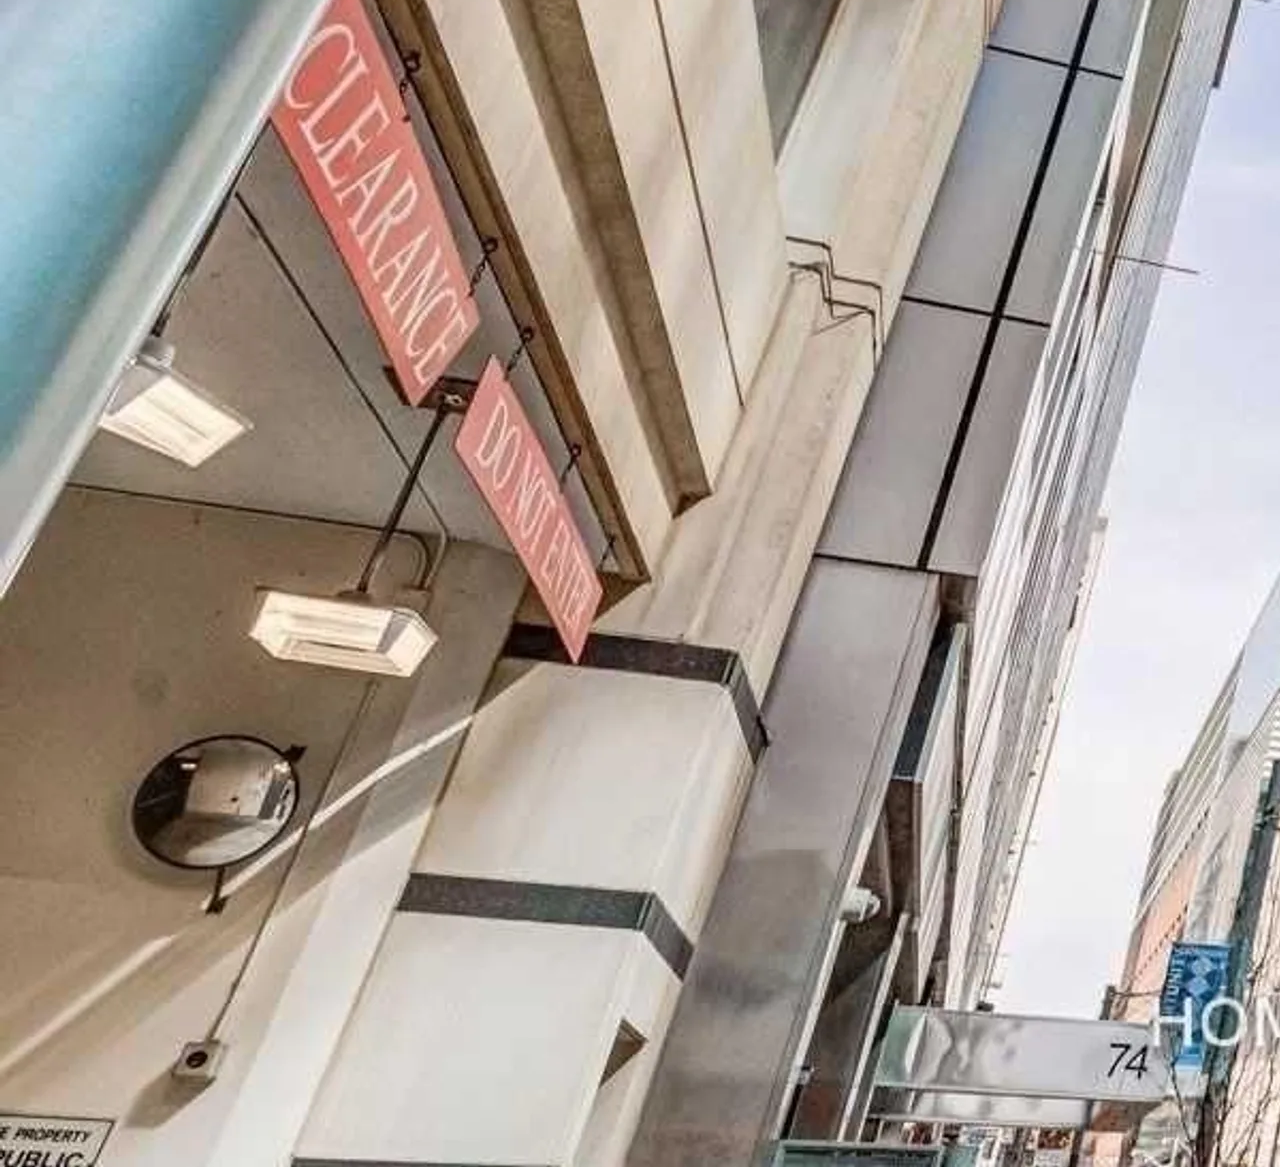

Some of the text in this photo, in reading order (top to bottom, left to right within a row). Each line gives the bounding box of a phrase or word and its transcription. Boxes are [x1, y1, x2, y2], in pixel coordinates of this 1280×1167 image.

[284, 23, 469, 385] CLEARANCE
[475, 397, 592, 636] DO NOT ENTER
[1108, 1043, 1147, 1080] 74
[13, 1127, 92, 1143] PROPERTY
